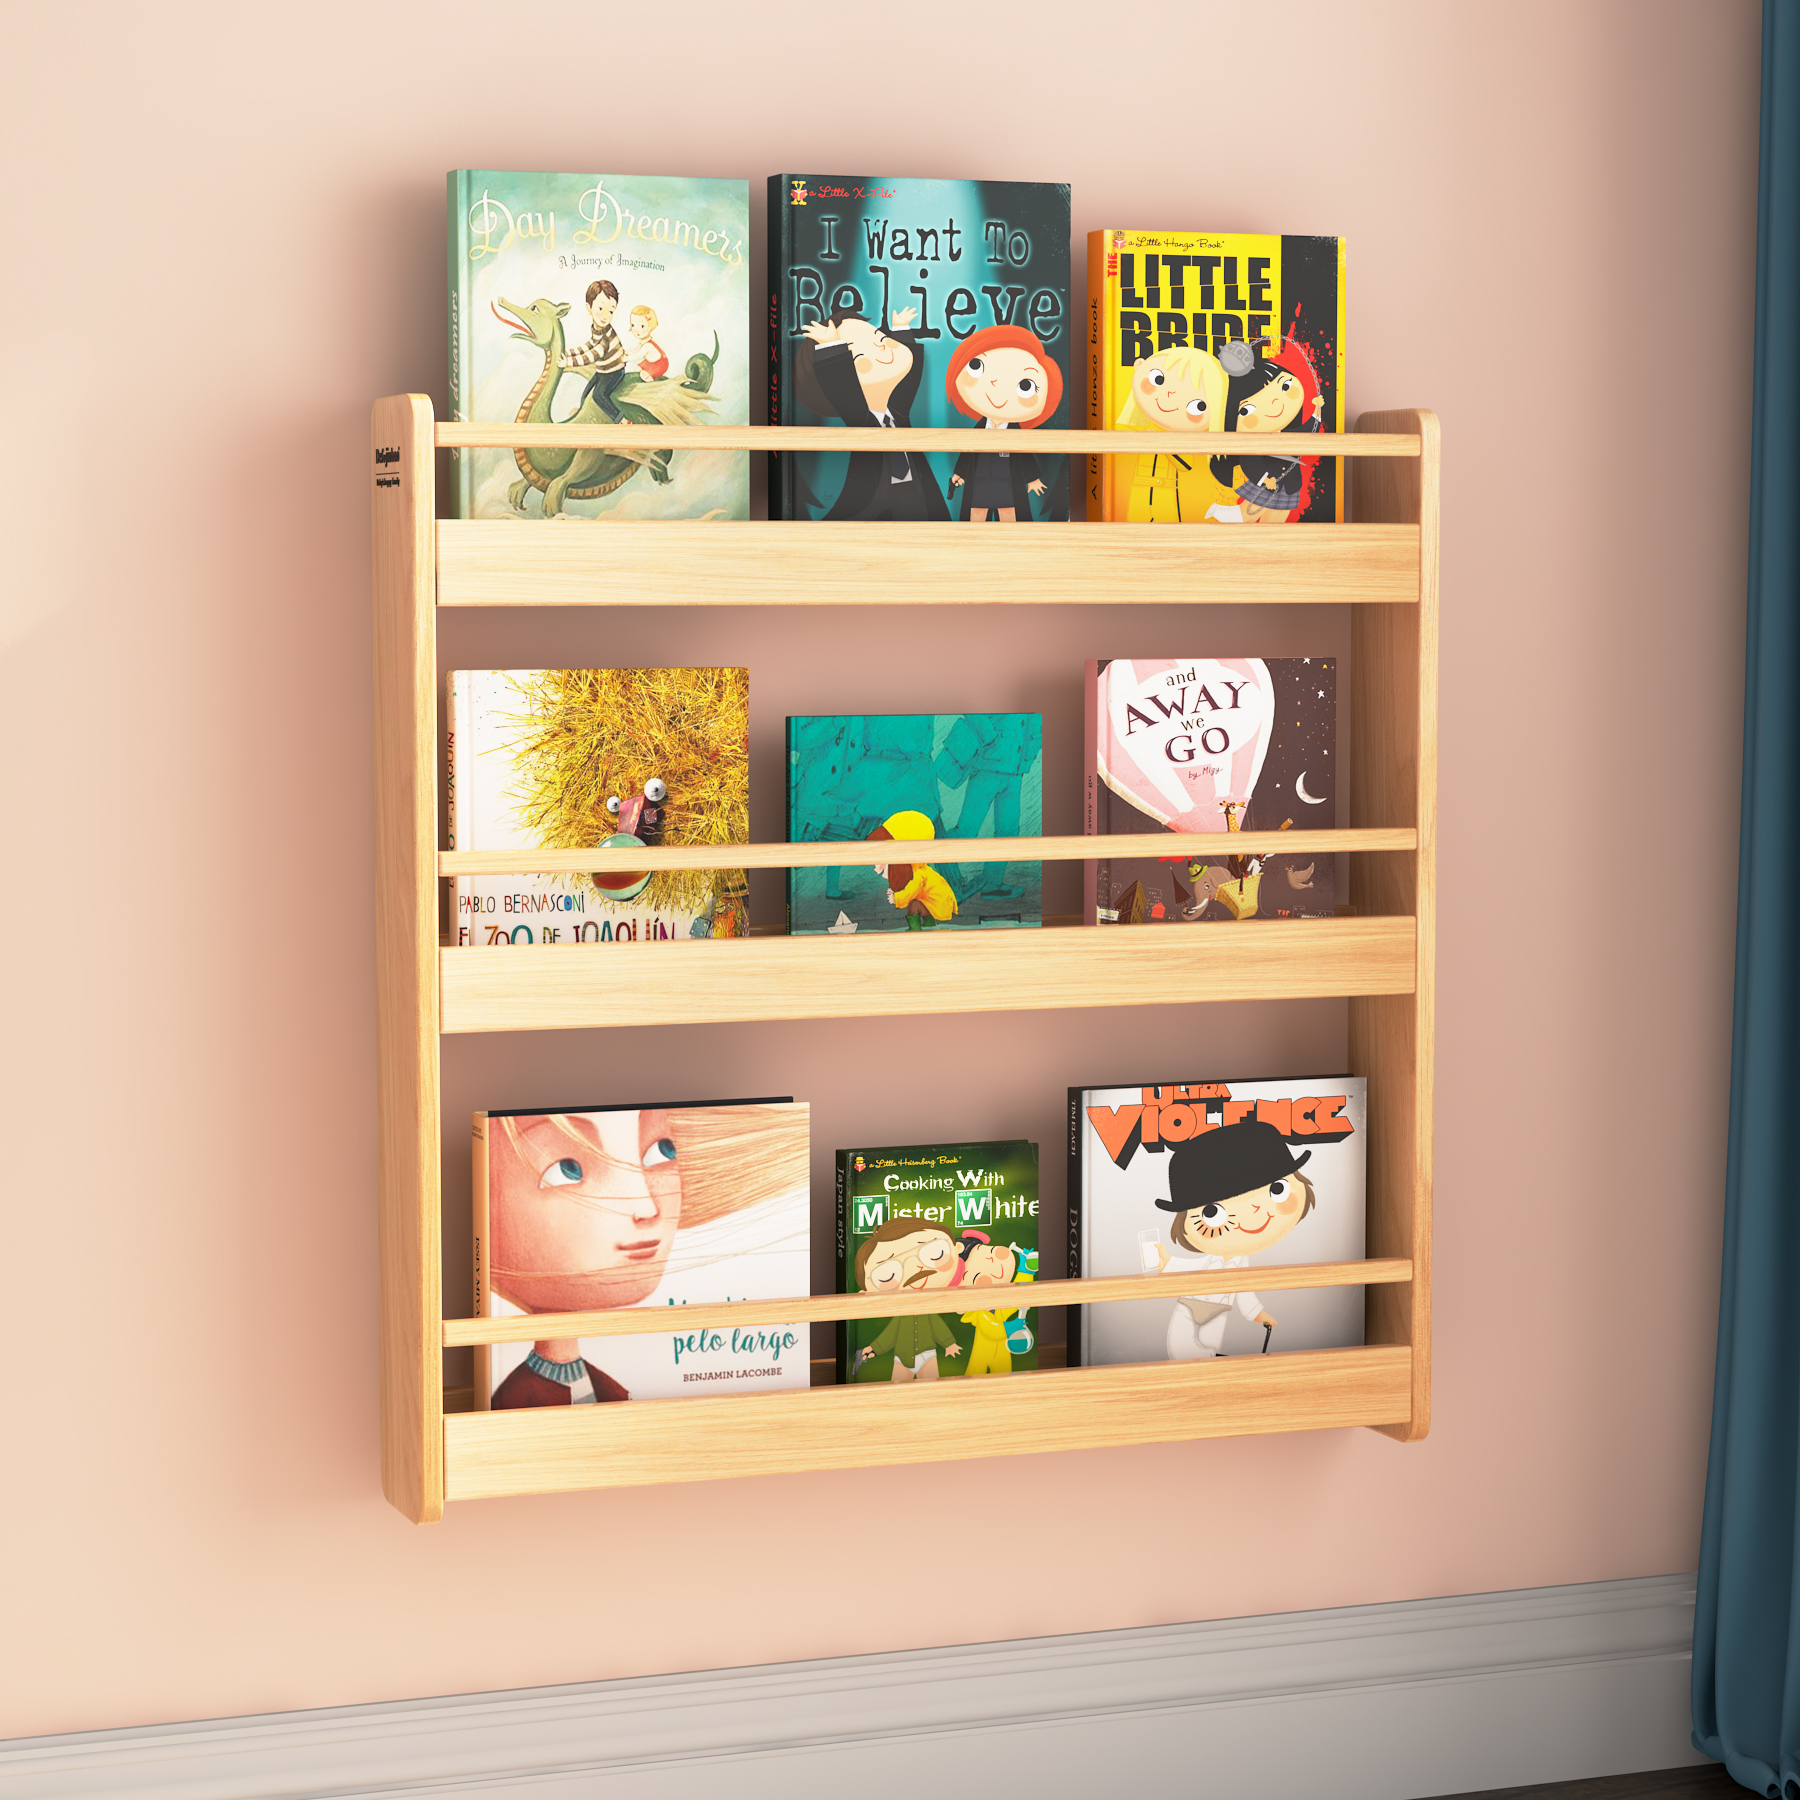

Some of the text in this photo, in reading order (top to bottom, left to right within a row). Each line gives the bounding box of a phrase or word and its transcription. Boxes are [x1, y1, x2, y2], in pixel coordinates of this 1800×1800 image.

[818, 186, 850, 198] Little
[468, 180, 744, 267] Day Dreamers
[819, 216, 1030, 266] I Want To
[1135, 236, 1162, 248] Little
[1195, 238, 1223, 249] Book
[558, 253, 666, 272] A Journey of Imagination
[1107, 252, 1118, 277] THE
[1120, 253, 1273, 312] LITTLE
[789, 265, 1062, 342] Believe
[1090, 297, 1098, 345] book
[449, 289, 459, 402] dreamers
[1090, 483, 1098, 501] A
[1165, 667, 1197, 687] and
[1125, 681, 1251, 737] AWAY
[1180, 717, 1205, 732] we
[1164, 726, 1230, 763] GO
[1087, 775, 1093, 789] go
[459, 891, 585, 914] PABLO BERNASCONI
[485, 925, 534, 945] ZOO
[1142, 1083, 1232, 1111] ULTRA
[875, 1159, 898, 1169] Little
[936, 1155, 960, 1165] Book
[883, 1168, 1005, 1192] Cooking With
[836, 1166, 845, 1258] Japan style
[673, 1327, 799, 1365] pelo largo
[682, 1366, 783, 1382] BENJAMIN LACOMBE
